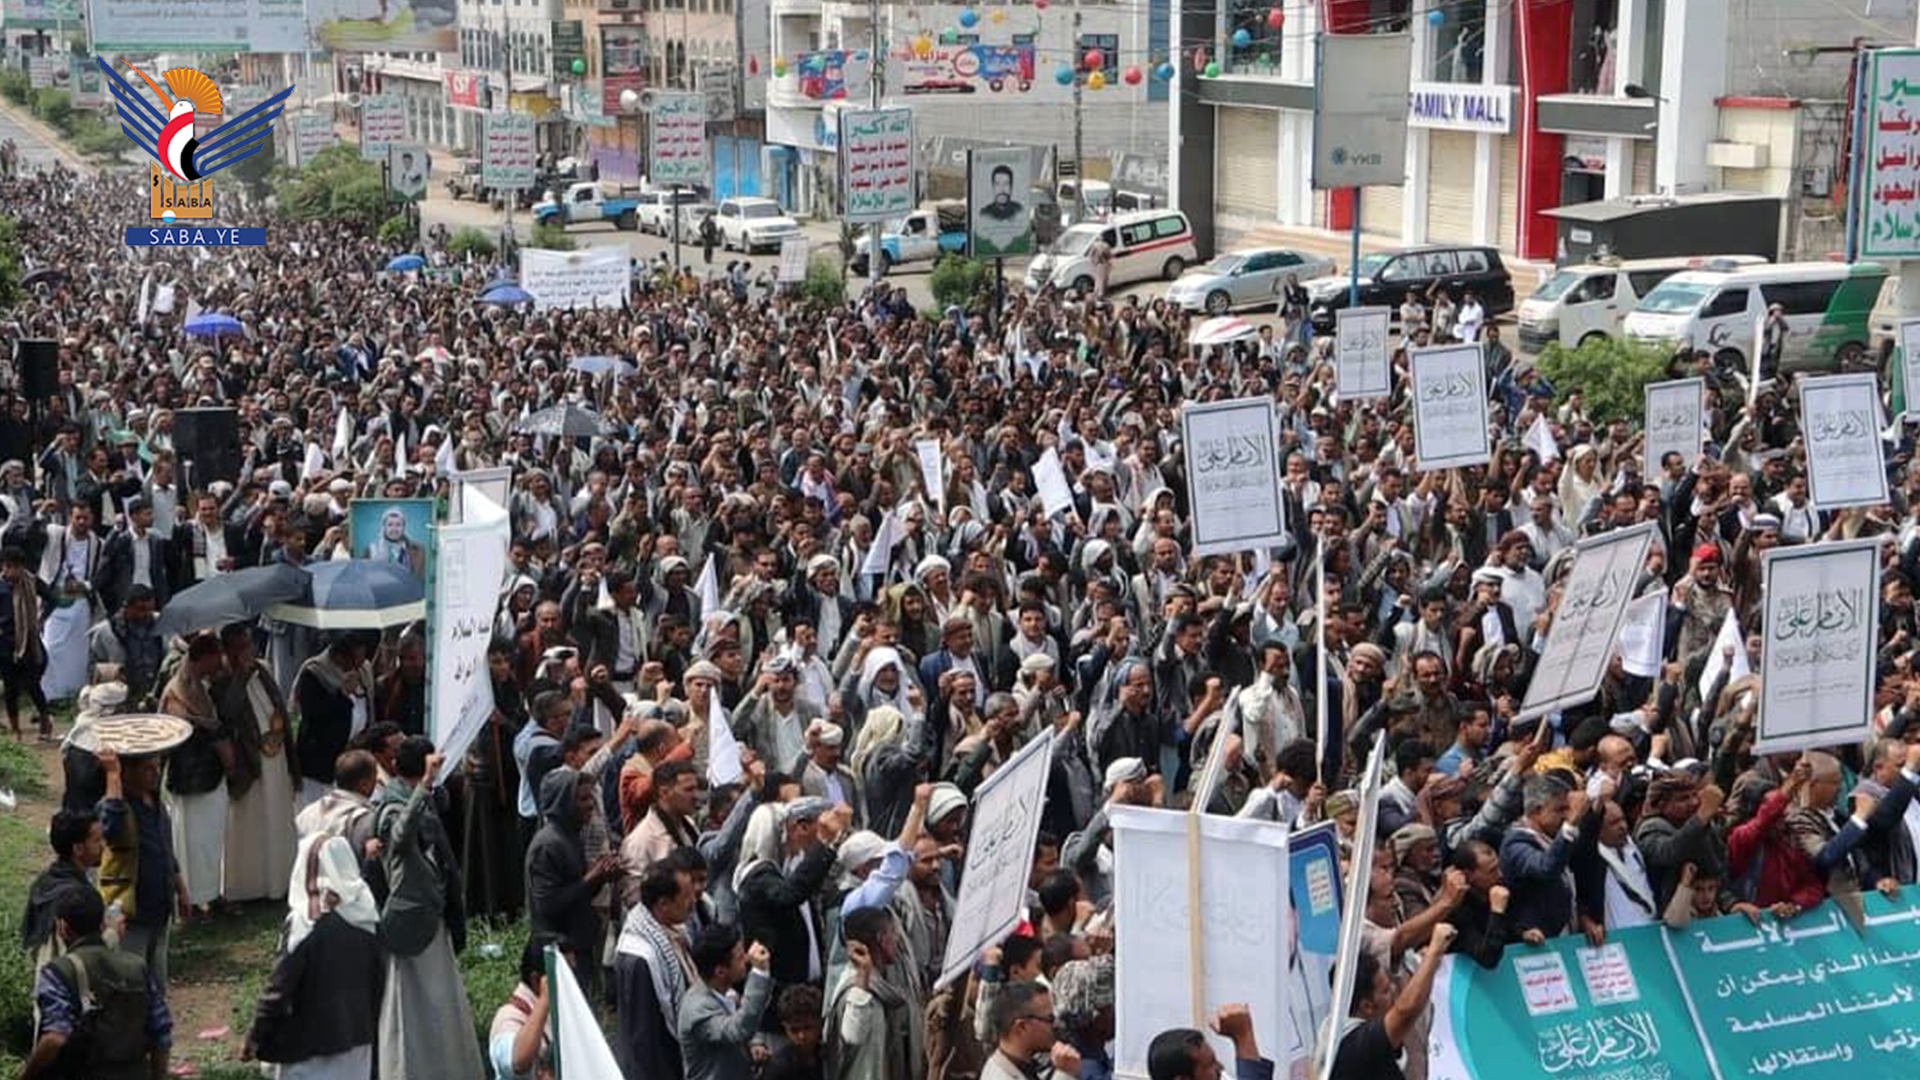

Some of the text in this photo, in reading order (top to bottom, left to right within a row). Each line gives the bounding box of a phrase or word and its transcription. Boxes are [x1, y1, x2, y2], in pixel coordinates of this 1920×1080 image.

[1463, 95, 1505, 122] MALL
[1693, 909, 1848, 954] الولاية
[1741, 967, 1806, 994] يمكن
[1808, 953, 1868, 983] الذي
[1716, 976, 1737, 998] أن
[1726, 1002, 1834, 1033] المسلمة
